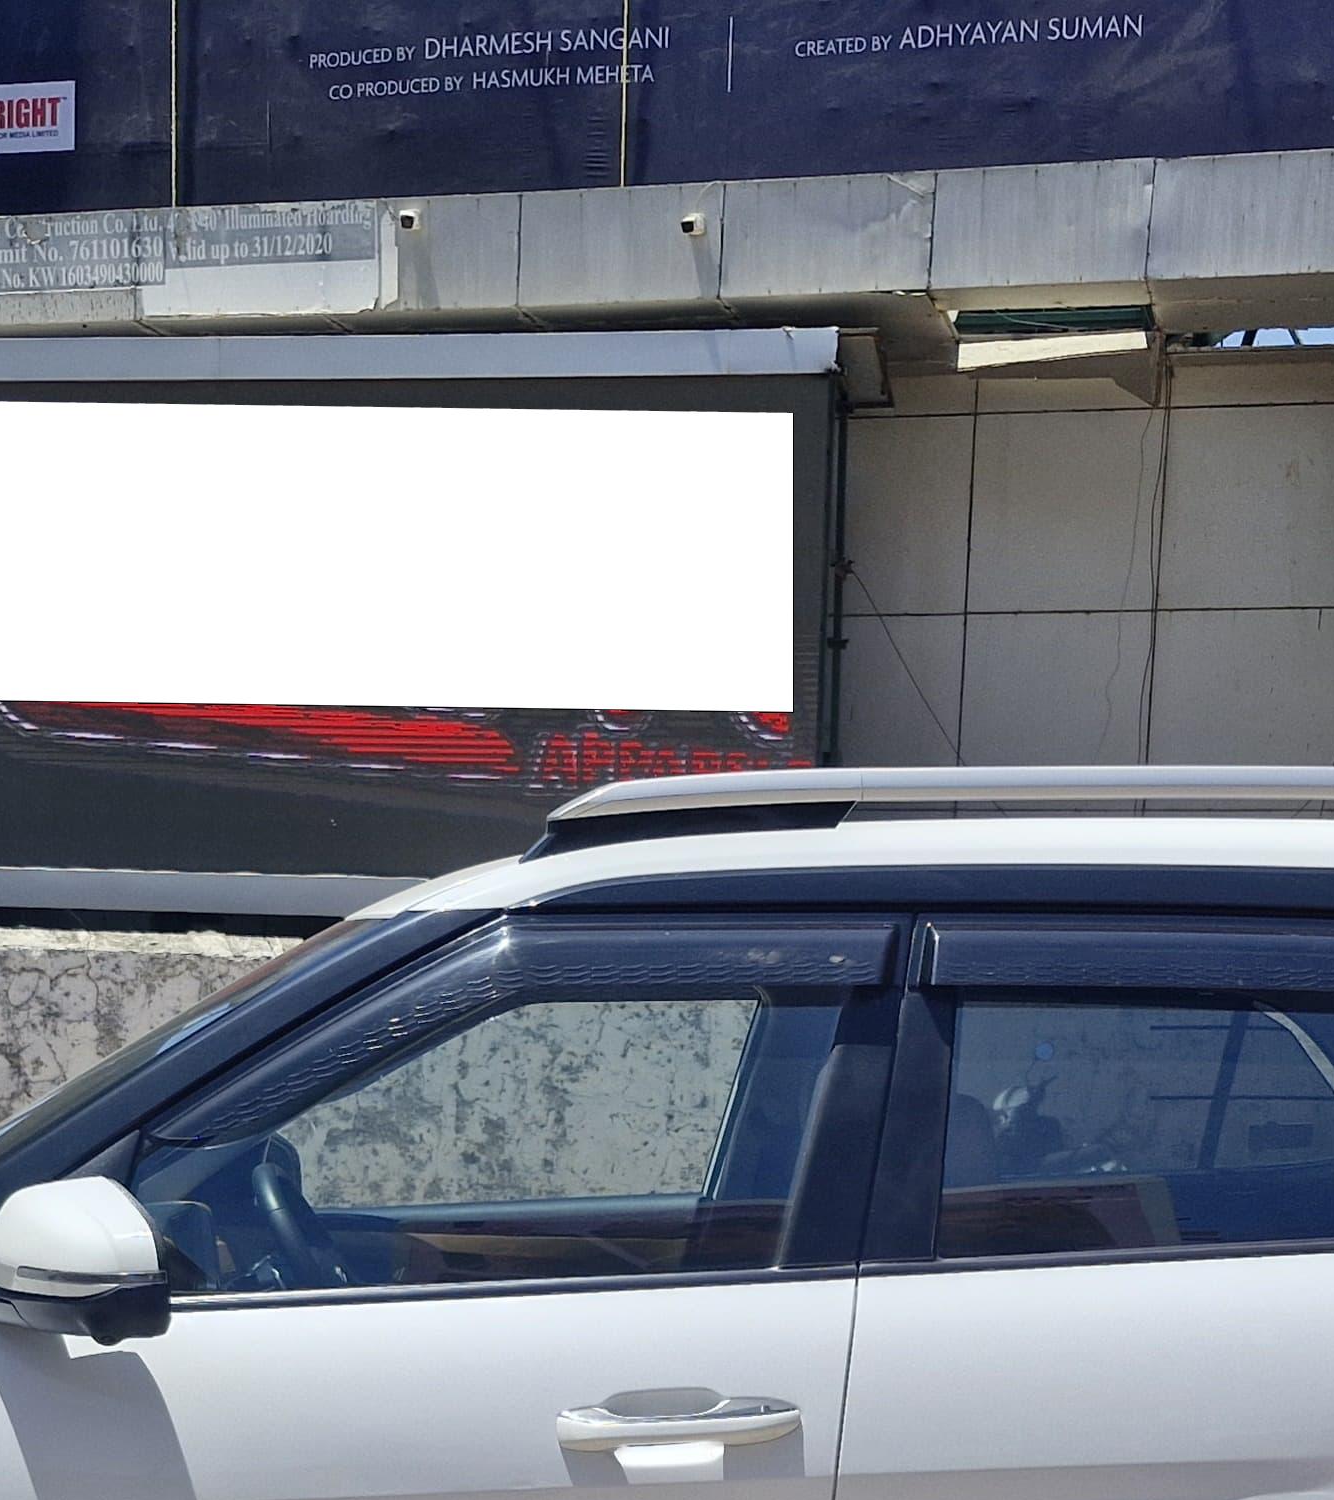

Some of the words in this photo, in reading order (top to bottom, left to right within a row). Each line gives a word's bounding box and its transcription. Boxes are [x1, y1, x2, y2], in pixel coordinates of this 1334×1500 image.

[309, 48, 393, 69] PRODUCED
[396, 46, 416, 62] BY
[424, 30, 552, 60] DHARMESH
[560, 26, 671, 52] SANGANI
[795, 36, 867, 58] CREATED
[870, 35, 892, 52] BY
[899, 18, 1040, 50] ADHYAYAN
[1047, 14, 1144, 42] SUMAN
[329, 84, 353, 100] CO
[357, 77, 440, 97] PRODUCED
[444, 76, 464, 91] BY
[472, 65, 571, 90] HASMUKH
[576, 64, 655, 85] MEHETA
[9, 131, 31, 139] MEDIA
[32, 129, 59, 138] LIMITED
[103, 213, 127, 234] Co.
[33, 243, 64, 263] No.
[69, 236, 163, 261] 761101630
[211, 243, 230, 265] up
[234, 240, 248, 258] to
[251, 231, 332, 258] 31/12/2020
